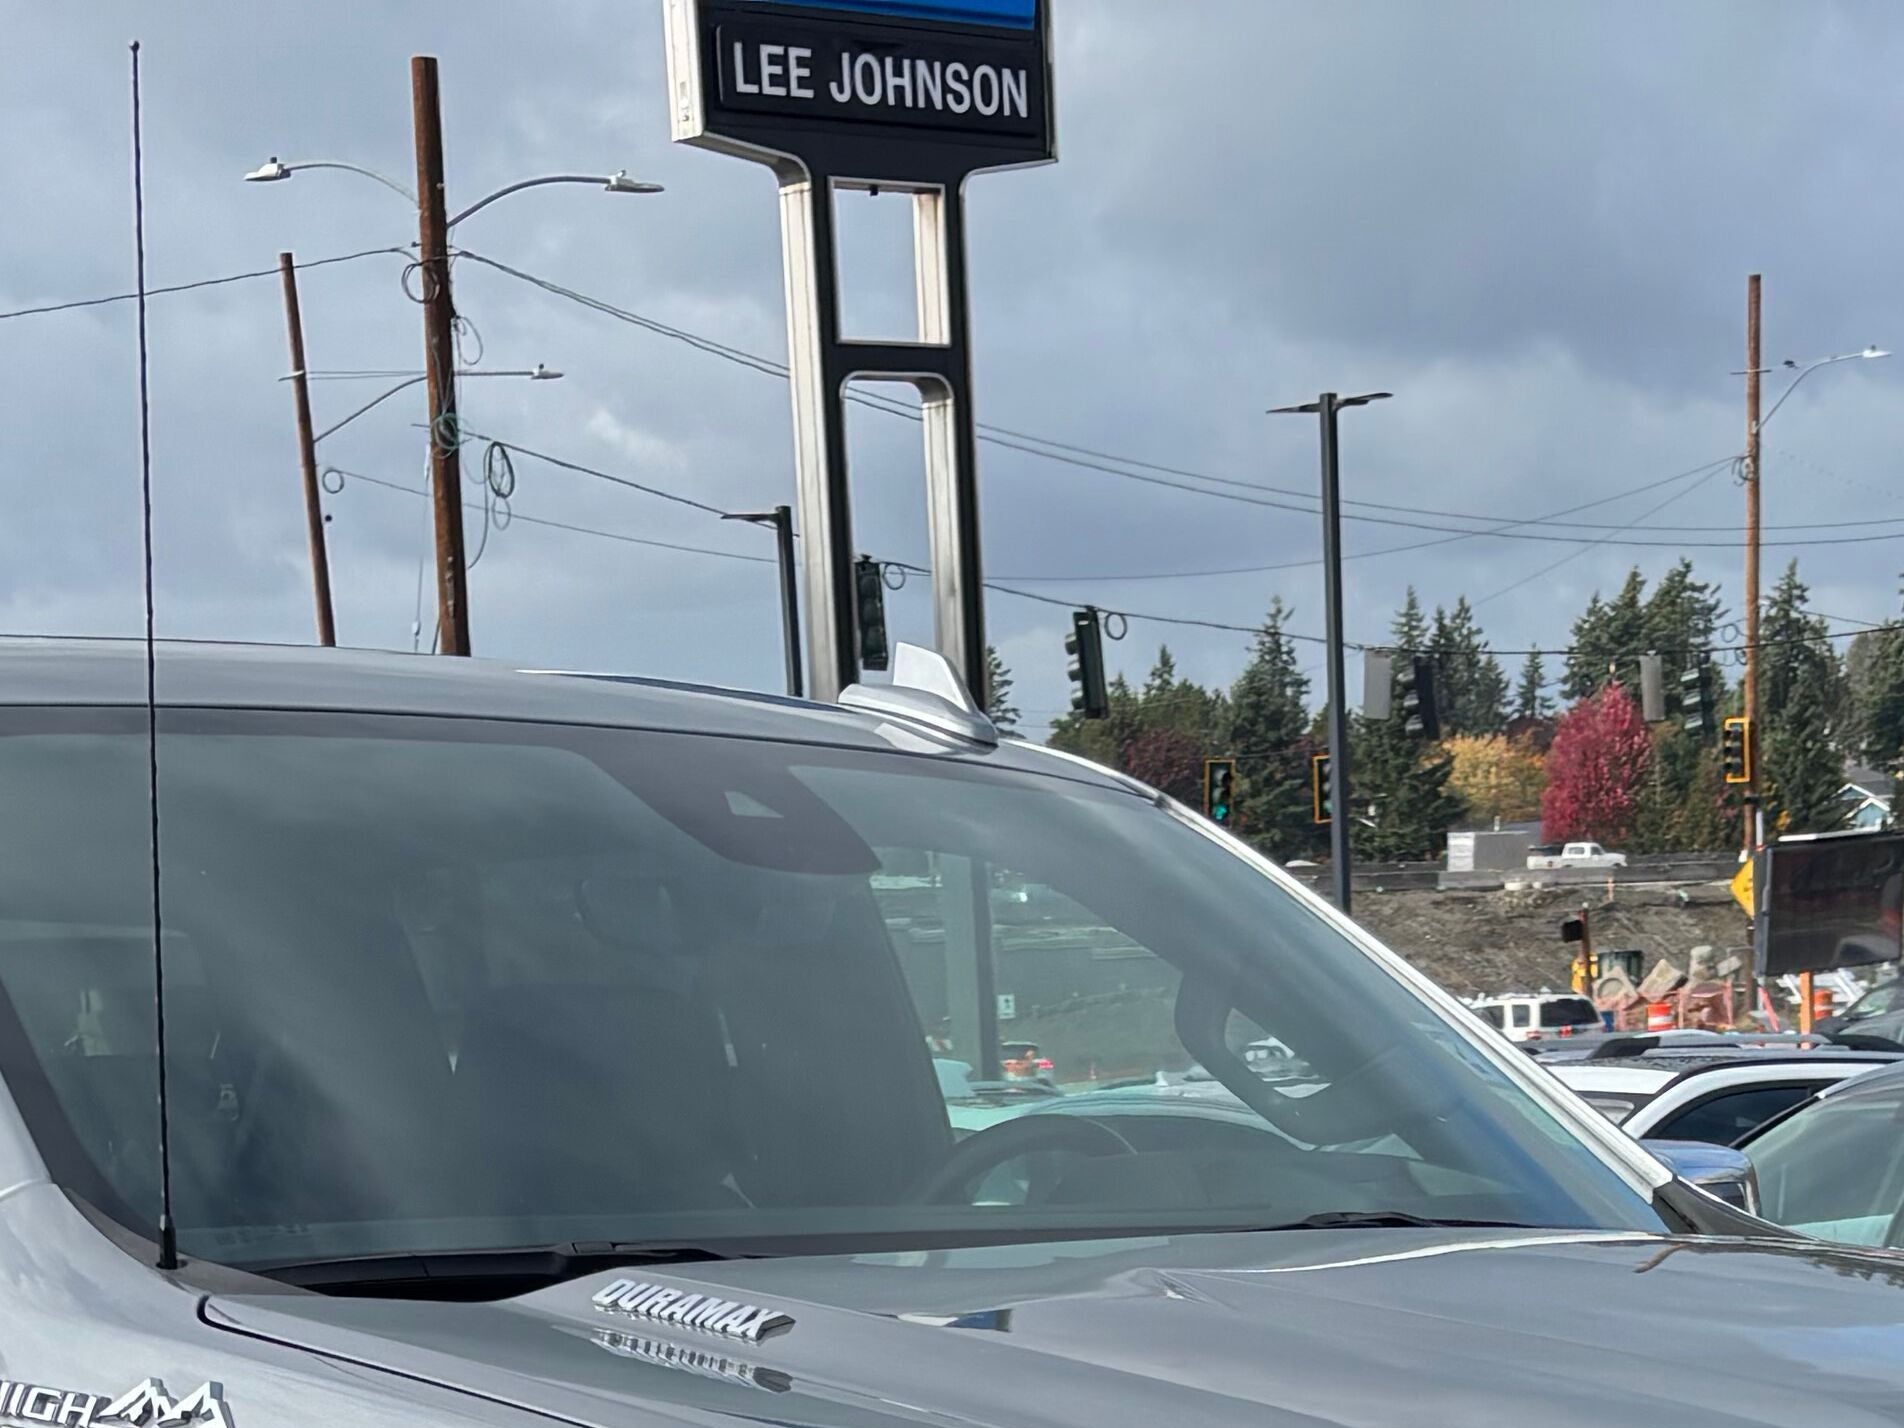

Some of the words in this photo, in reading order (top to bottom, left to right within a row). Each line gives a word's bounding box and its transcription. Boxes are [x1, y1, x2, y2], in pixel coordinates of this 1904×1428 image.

[733, 41, 815, 99] LEE
[829, 51, 1029, 119] JOHNSON
[592, 1278, 792, 1343] DURAMAX
